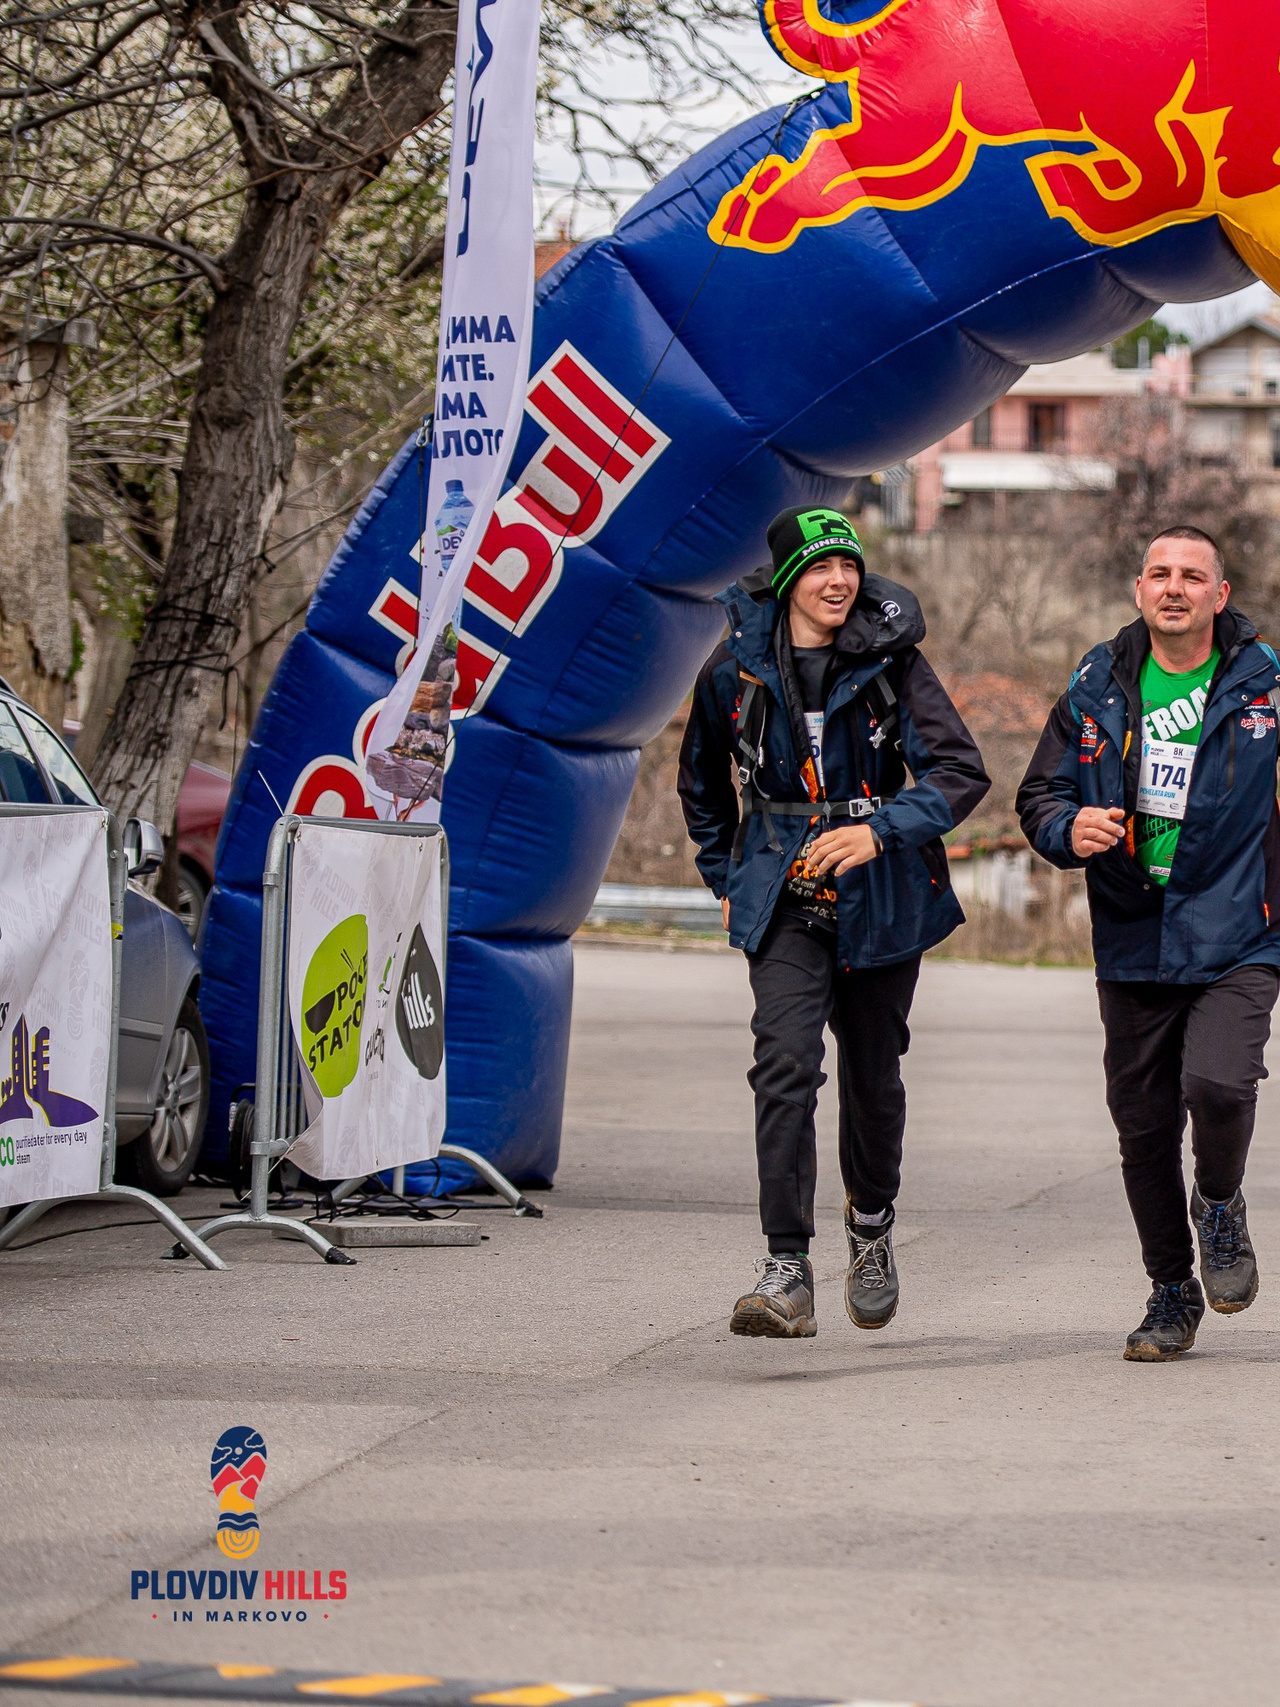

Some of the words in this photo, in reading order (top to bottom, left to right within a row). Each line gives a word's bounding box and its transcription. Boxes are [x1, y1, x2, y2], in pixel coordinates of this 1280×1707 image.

[445, 315, 516, 350] ИМА
[460, 346, 664, 631] Bull
[1173, 748, 1184, 756] 8K
[1151, 763, 1187, 790] 174
[1164, 790, 1176, 798] RUN
[74, 1129, 88, 1144] day
